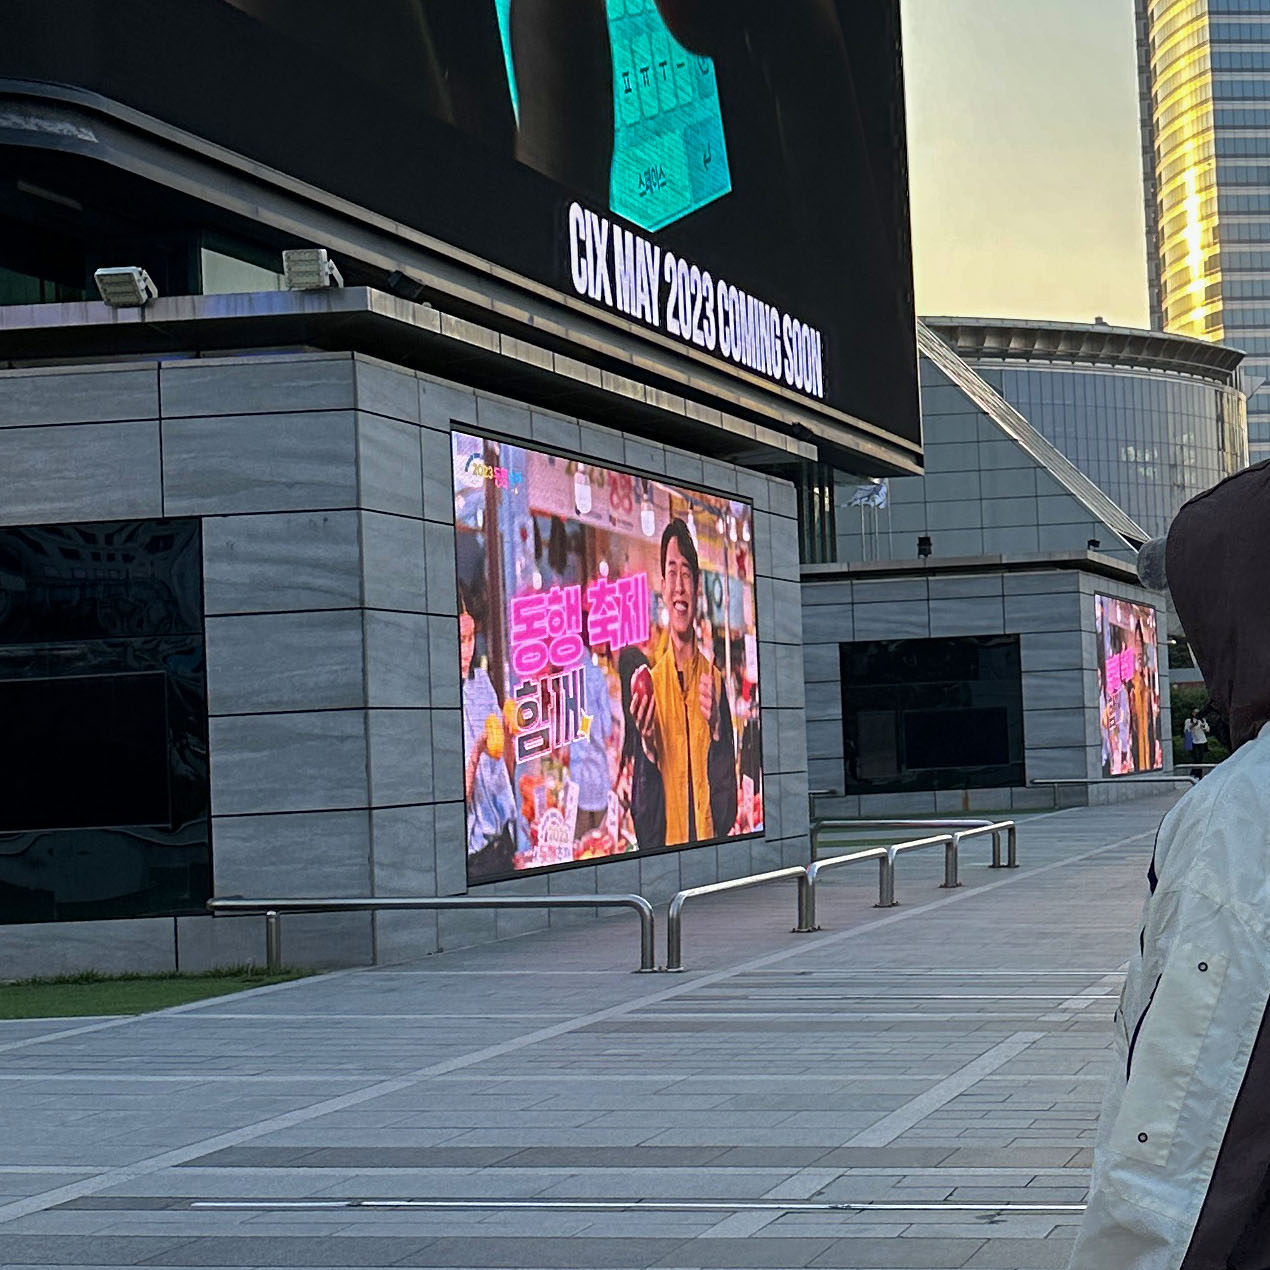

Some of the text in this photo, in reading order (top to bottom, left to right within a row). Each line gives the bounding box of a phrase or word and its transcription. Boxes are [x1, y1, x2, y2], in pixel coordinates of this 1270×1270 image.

[638, 163, 667, 198] 스페이스
[569, 202, 824, 398] CIX MAY 2023 COMING SOON
[511, 572, 649, 675] 동행 축제
[514, 665, 586, 764] 함께
